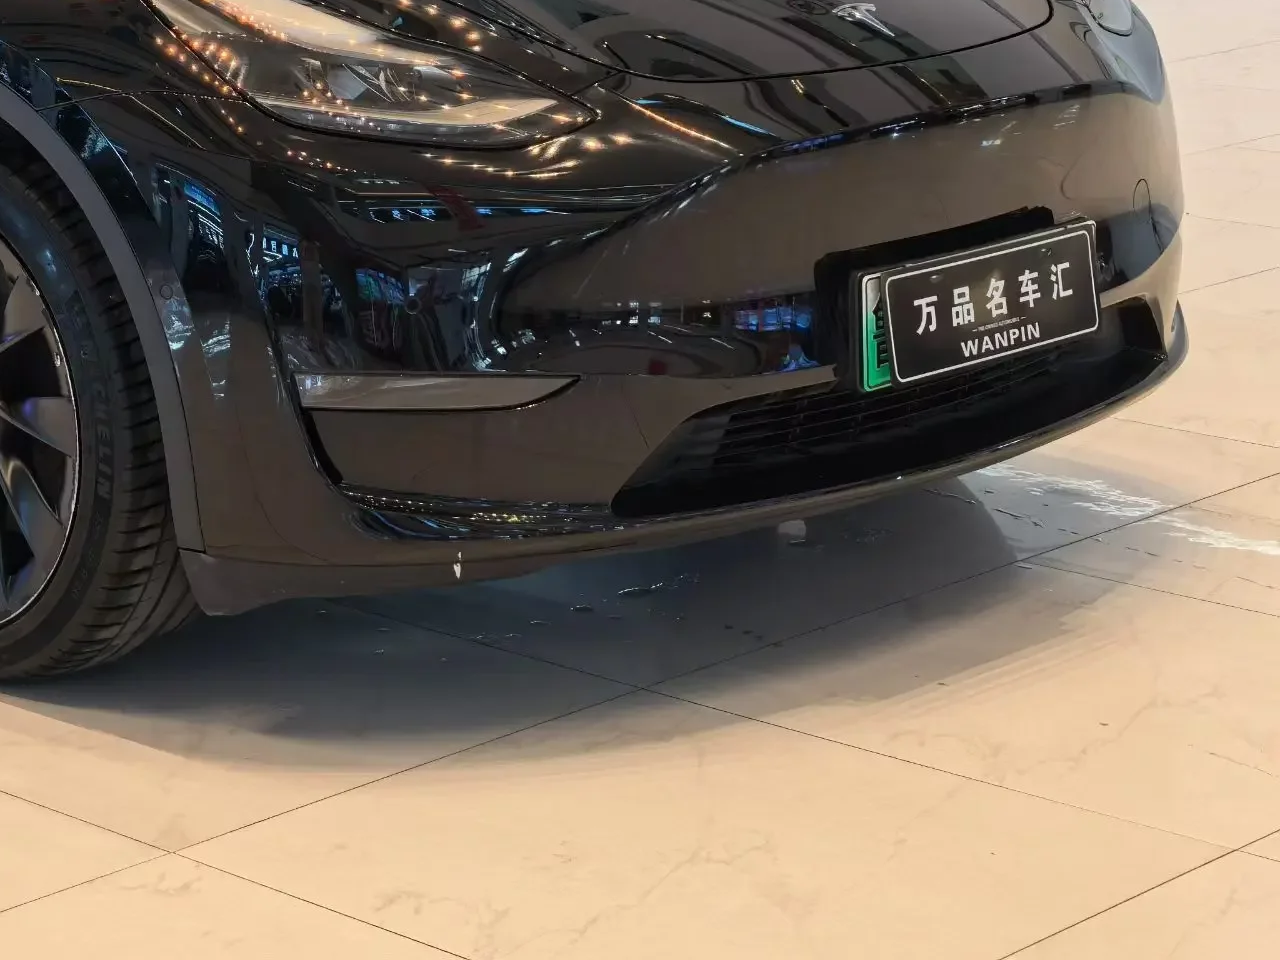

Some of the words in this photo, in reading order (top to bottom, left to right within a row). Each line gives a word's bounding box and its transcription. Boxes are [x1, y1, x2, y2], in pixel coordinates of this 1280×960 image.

[913, 262, 1074, 336] 万品名车汇
[960, 322, 1040, 358] WANPIN
